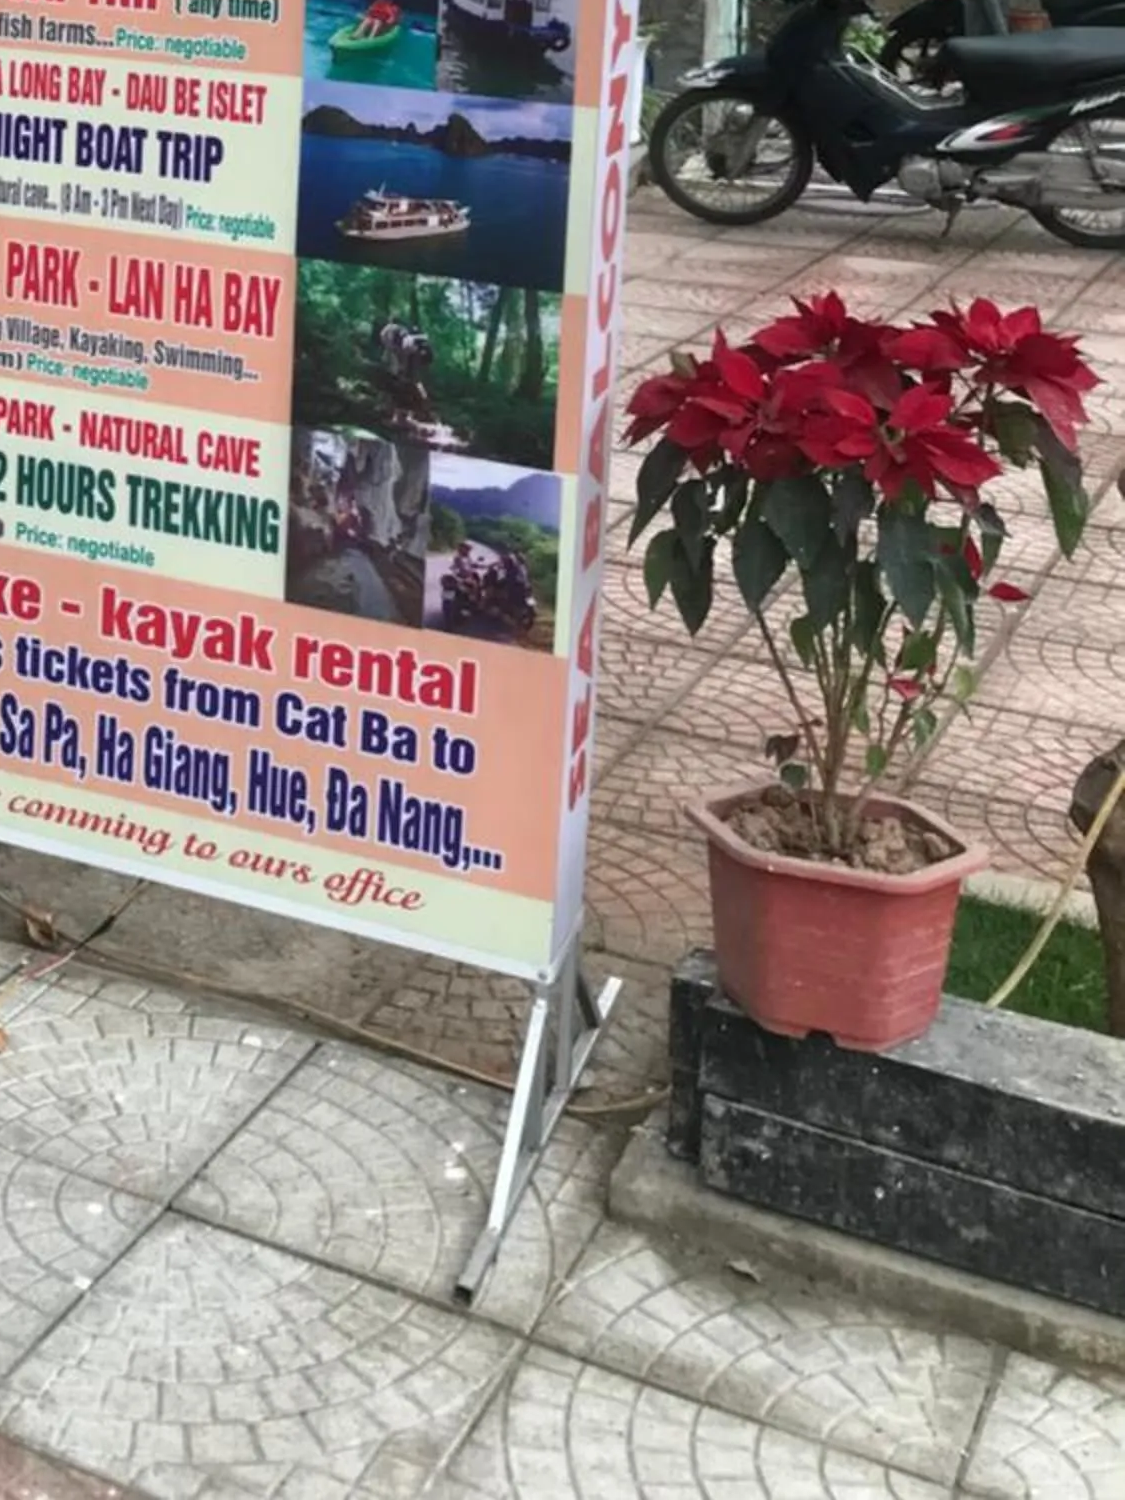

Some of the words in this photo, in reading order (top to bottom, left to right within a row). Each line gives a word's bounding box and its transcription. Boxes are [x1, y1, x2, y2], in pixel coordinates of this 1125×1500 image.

[39, 19, 114, 49] farms...
[9, 61, 61, 102] LONG
[68, 67, 104, 105] BAY
[127, 73, 167, 114] DAU
[175, 79, 200, 116] BE
[208, 82, 266, 124] ISLET
[76, 121, 145, 173] BOAT
[156, 129, 223, 182] TRIP
[7, 241, 79, 307] PARK
[109, 256, 166, 316] LAN
[175, 265, 213, 327] HA
[223, 272, 281, 338] BAY
[7, 318, 65, 350] Village,
[69, 327, 148, 365] Kayaking,
[154, 338, 258, 382] Swimming...
[80, 410, 188, 465] NATURAL
[196, 430, 261, 477] CAVE
[16, 455, 115, 523] HOURS
[126, 474, 280, 554] TREKKING
[16, 522, 61, 550] Price:
[67, 531, 155, 567] negotiable
[101, 588, 276, 671] kayak
[293, 635, 477, 714] rental
[17, 639, 150, 702] tickets
[164, 668, 259, 727] from
[276, 692, 346, 746] Cat
[361, 710, 417, 762] Ba
[433, 727, 475, 774] to
[0, 694, 34, 758] Sa
[44, 702, 85, 778] Pa,
[97, 715, 132, 781] Ha
[145, 724, 236, 815] Giang,
[248, 749, 315, 832] Hue,
[326, 767, 367, 837] Đa
[8, 796, 175, 853] comming
[184, 833, 218, 860] to
[229, 850, 312, 884] ours
[324, 867, 426, 910] office
